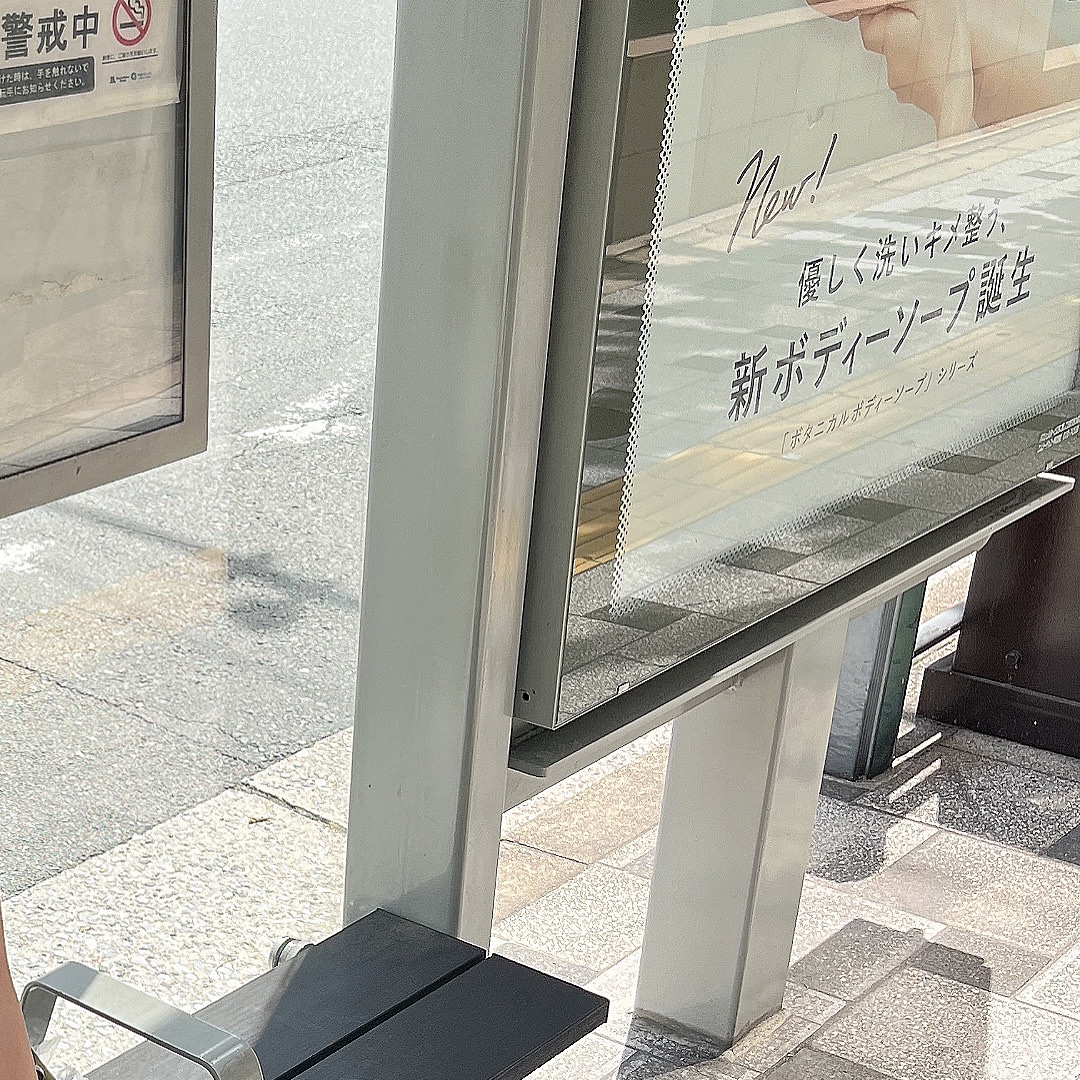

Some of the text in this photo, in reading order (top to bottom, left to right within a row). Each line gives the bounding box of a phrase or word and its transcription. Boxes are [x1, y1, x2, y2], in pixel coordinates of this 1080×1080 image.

[727, 133, 838, 254] New!
[728, 246, 1036, 423] 新ボディーソープ誕生
